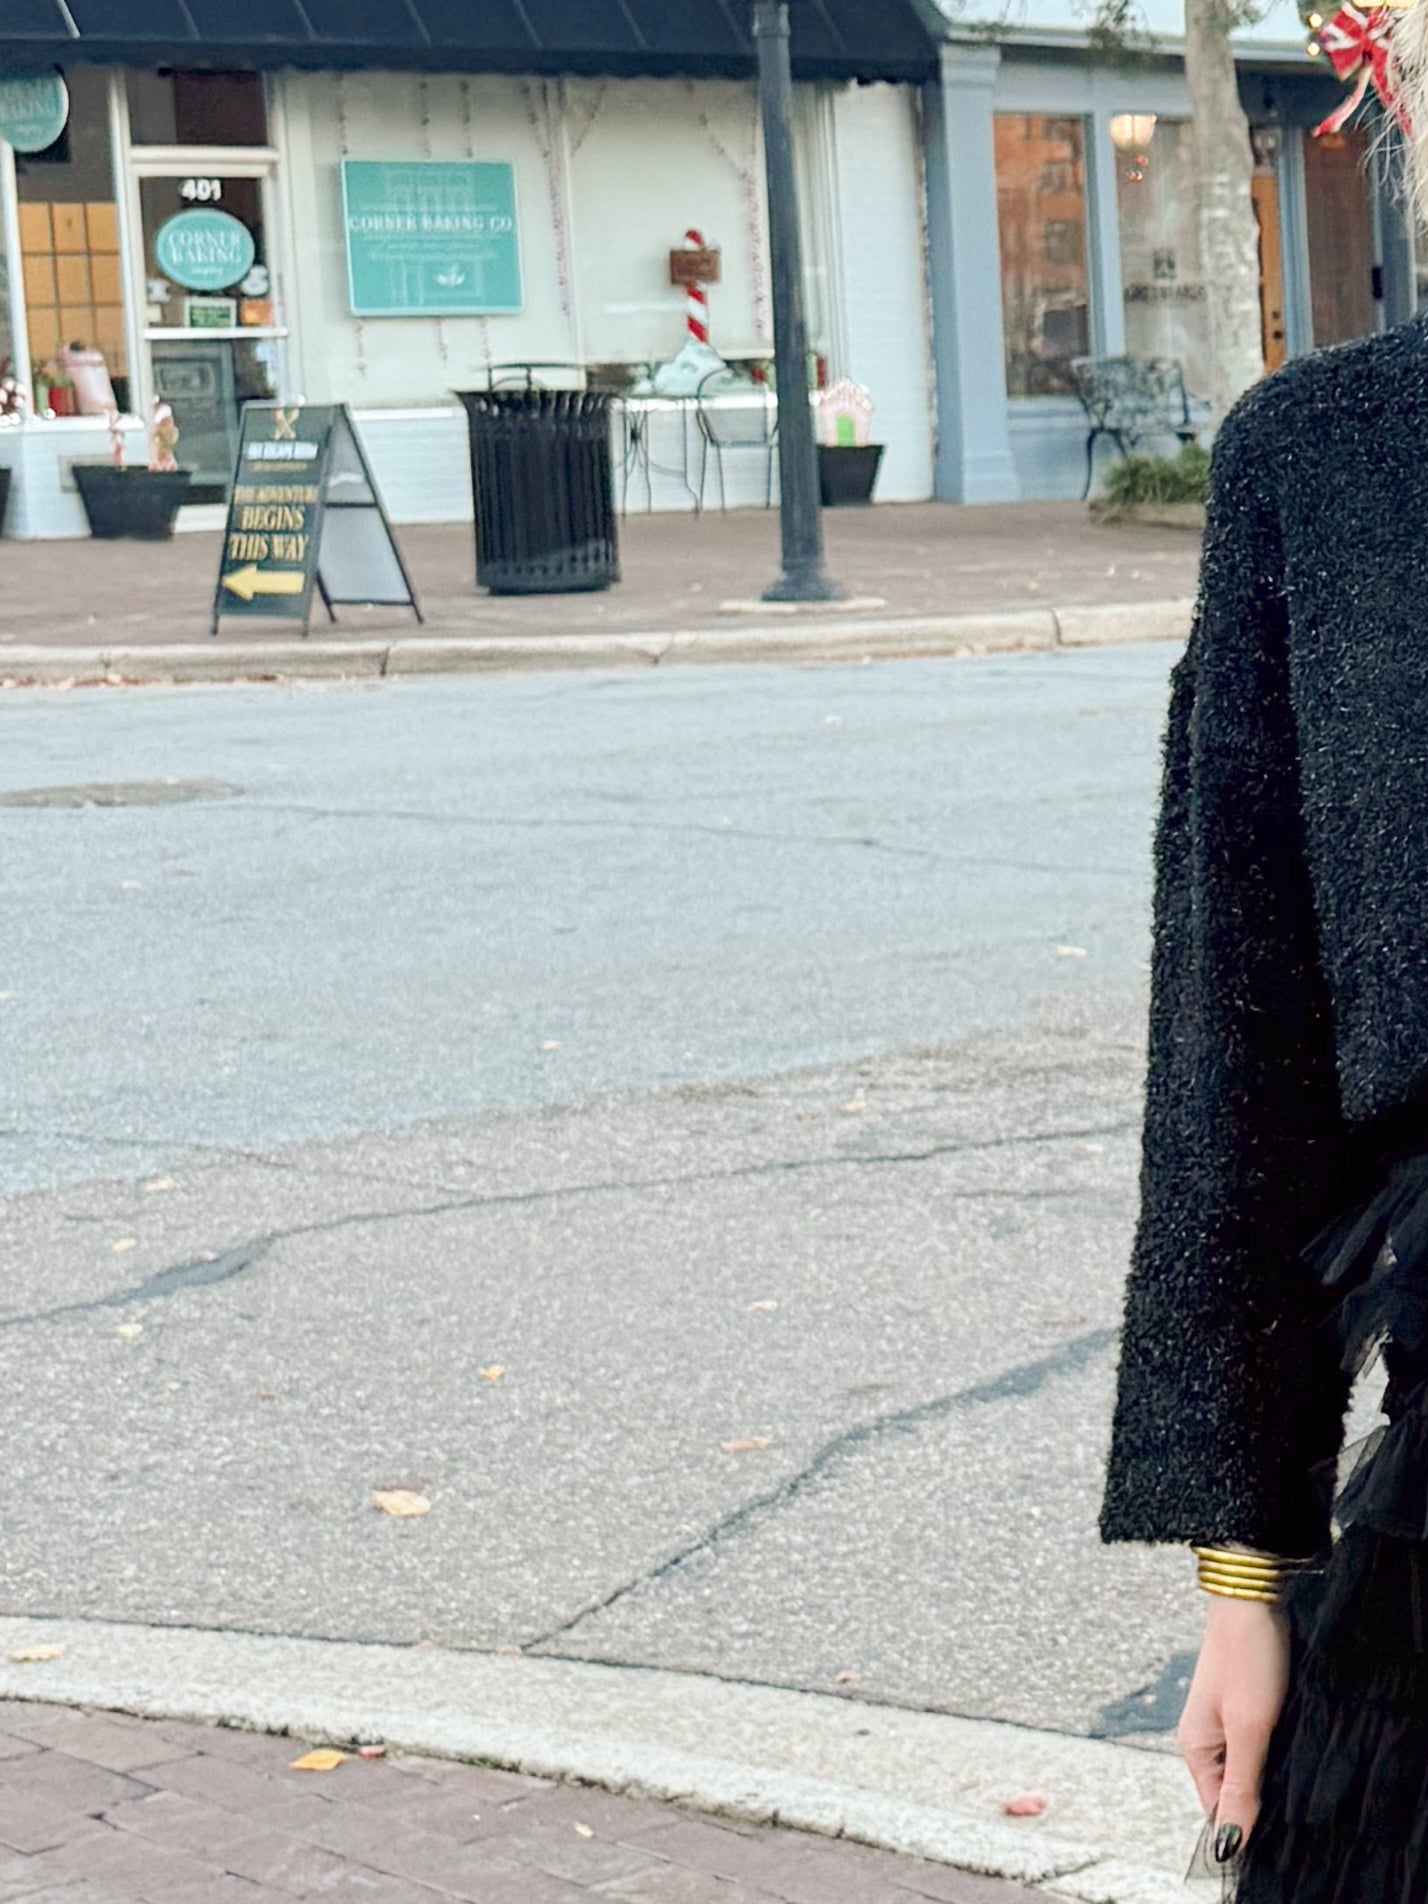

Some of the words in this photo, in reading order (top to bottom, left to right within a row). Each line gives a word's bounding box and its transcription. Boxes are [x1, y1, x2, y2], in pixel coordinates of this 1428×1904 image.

[182, 179, 221, 201] 401
[350, 213, 417, 232] CORNER
[423, 214, 485, 231] BAKING
[168, 229, 241, 247] CORNER
[171, 246, 241, 265] BAKING
[240, 506, 306, 530] BEGINS
[230, 533, 269, 560] THIS
[271, 534, 309, 561] WAY
